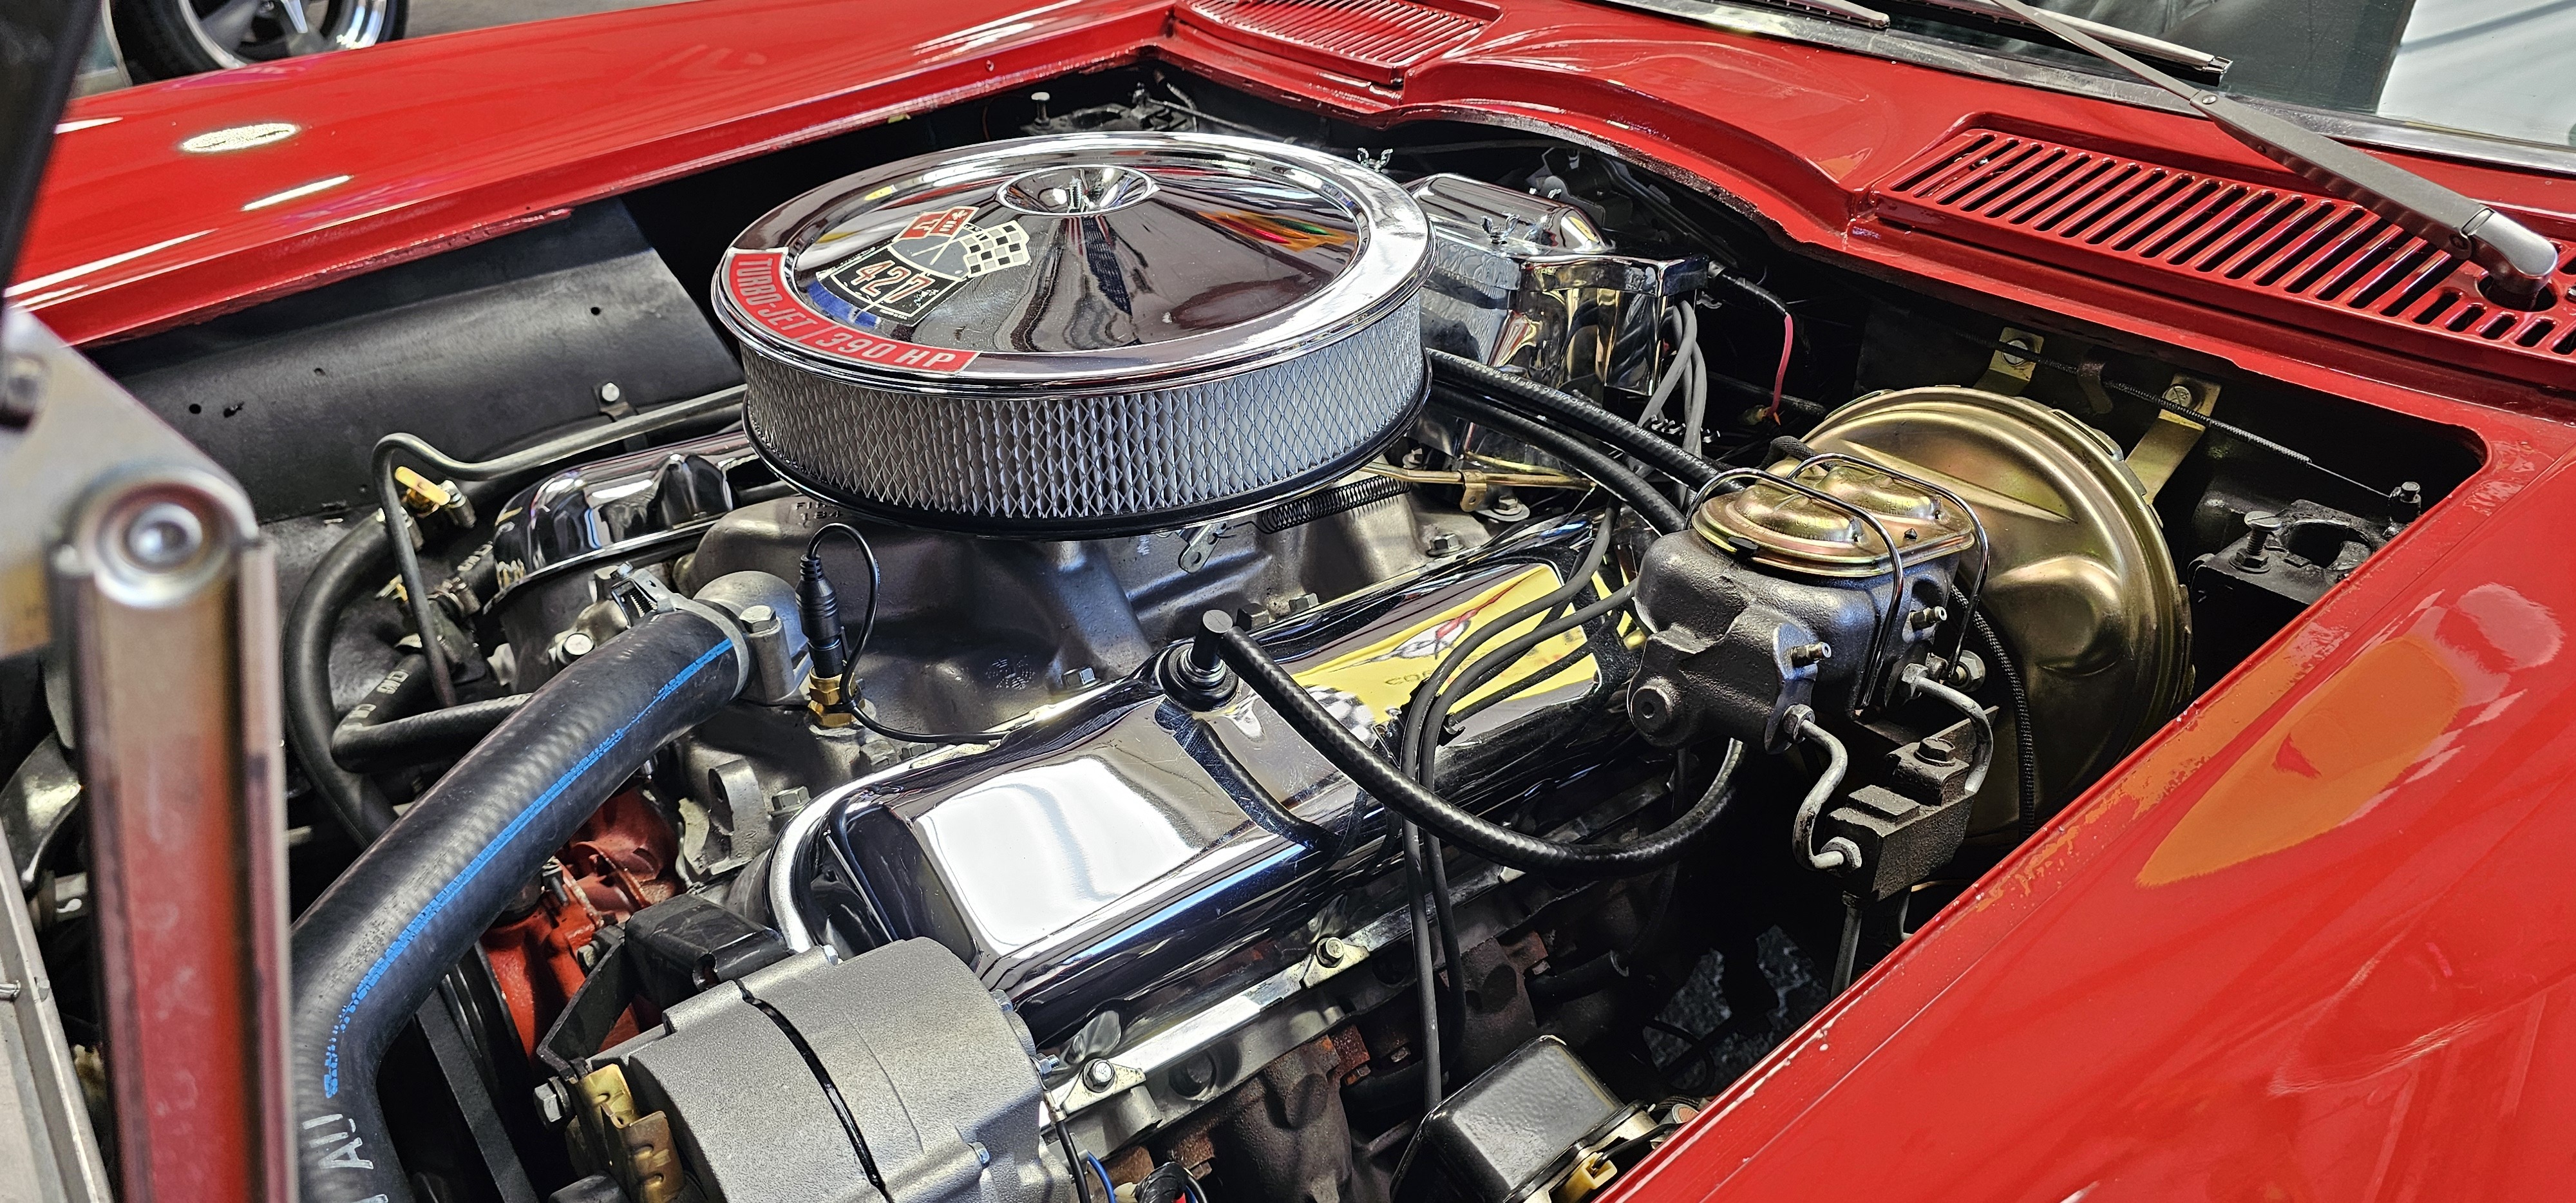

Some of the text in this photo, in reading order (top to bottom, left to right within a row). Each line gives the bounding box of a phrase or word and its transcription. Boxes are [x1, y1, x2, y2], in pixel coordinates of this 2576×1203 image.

[851, 260, 936, 303] 427
[736, 258, 956, 368] TURBO-JET 390 HP
[1586, 404, 1607, 416] Line
[1607, 413, 1631, 426] Fuel
